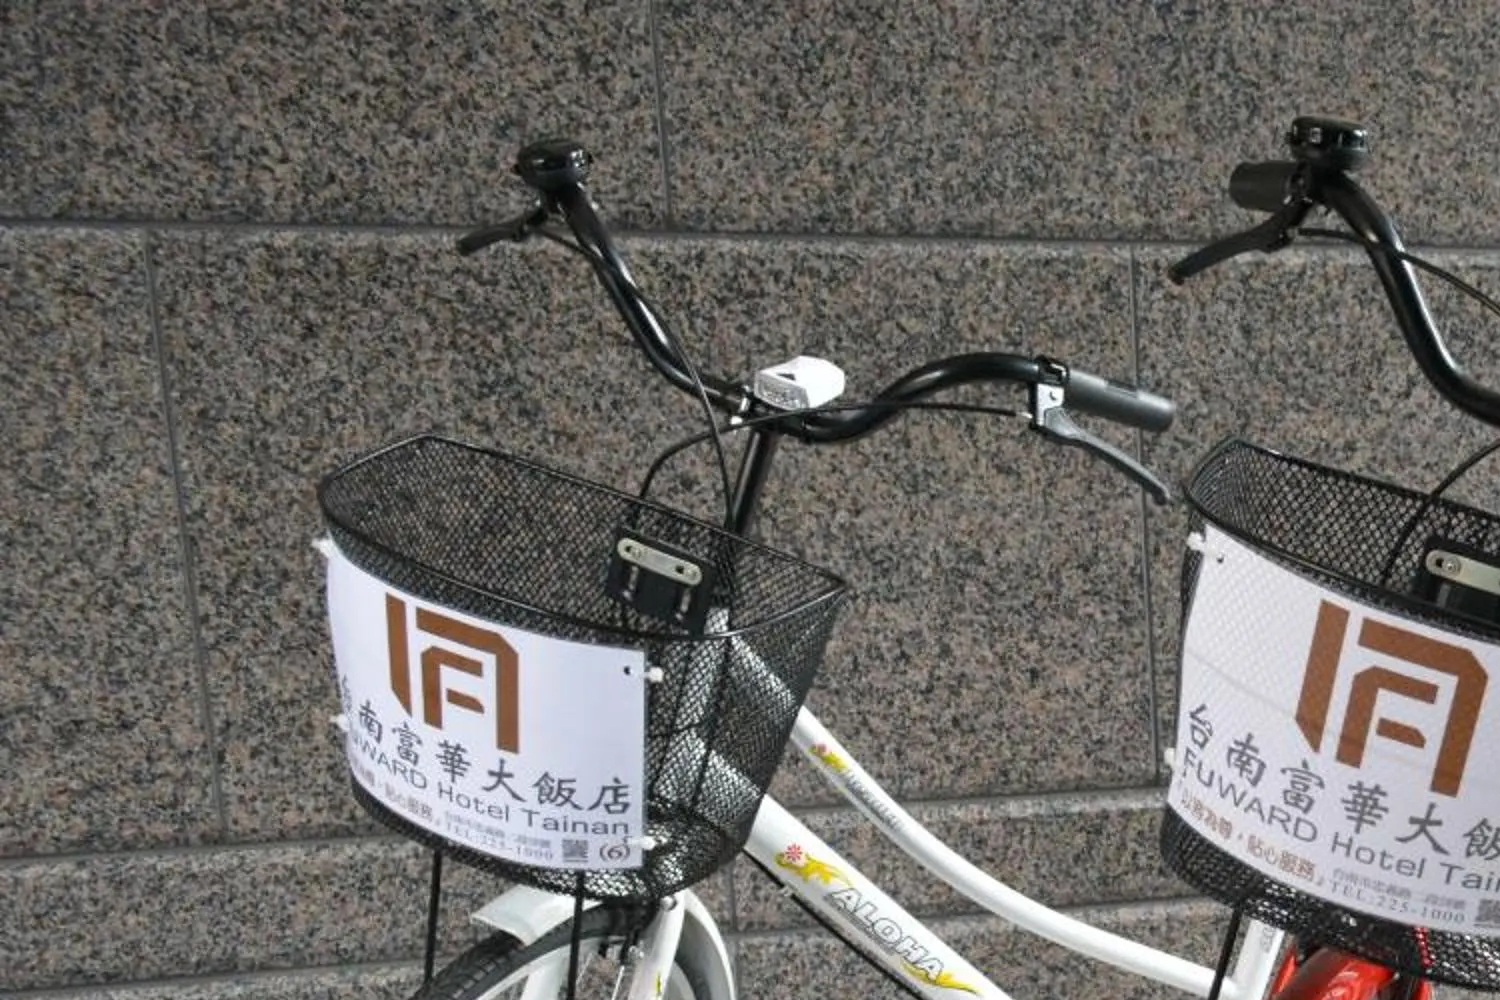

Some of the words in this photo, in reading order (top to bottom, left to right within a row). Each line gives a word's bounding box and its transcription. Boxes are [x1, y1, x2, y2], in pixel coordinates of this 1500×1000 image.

[352, 732, 427, 790] UWARD
[438, 782, 510, 822] Hotel
[522, 808, 630, 835] Tainan
[1182, 746, 1318, 843] FUWARD
[1331, 831, 1426, 880] Hotel
[599, 843, 631, 863] (6)
[829, 886, 945, 982] ALOHA
